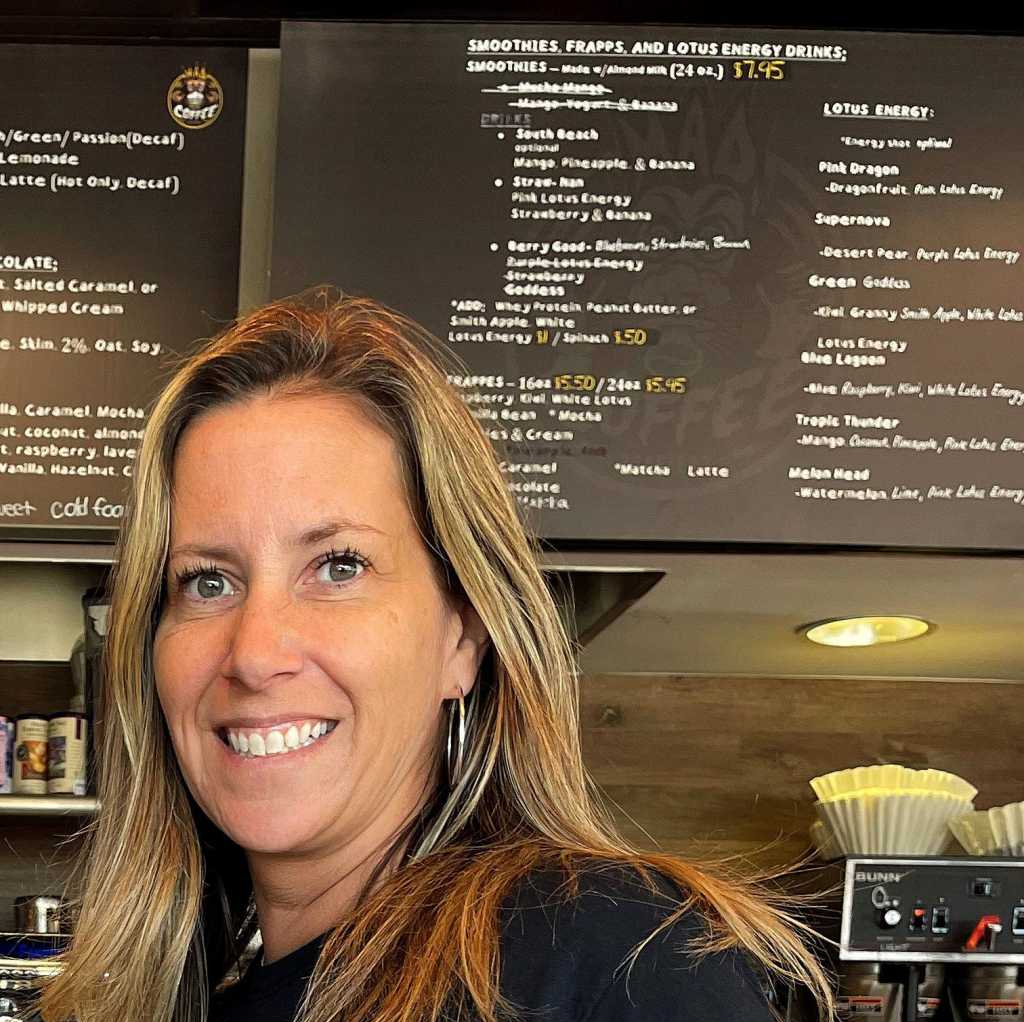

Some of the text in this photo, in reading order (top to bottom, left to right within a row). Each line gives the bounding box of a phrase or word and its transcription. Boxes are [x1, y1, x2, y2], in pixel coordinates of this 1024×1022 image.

[632, 40, 847, 61] AND LOTUS ENERGY DRINKS:
[466, 60, 547, 72] SMOOTHIES
[670, 63, 694, 77] (24
[734, 59, 785, 79] $7.95
[824, 102, 934, 118] LOTUS ENERGY:
[516, 128, 598, 140] South Beach
[649, 158, 695, 170] Banana
[819, 161, 899, 177] Pink Dragon
[0, 174, 46, 186] Latte
[51, 173, 82, 192] (Hot
[127, 175, 179, 194] Decaf)
[512, 192, 631, 207] Pink Lotus Energy
[511, 208, 589, 222] Strawberry
[606, 209, 651, 220] Banana
[815, 212, 890, 226] Supernova
[508, 240, 549, 254] Berry
[14, 278, 157, 293] Salted or
[809, 274, 856, 287] Green
[2, 300, 67, 314] Whipped
[71, 301, 123, 314] Cream
[495, 301, 531, 313] Whey
[533, 301, 581, 312] Protein
[587, 302, 630, 313] Peanut
[450, 315, 575, 328] Smith White
[449, 331, 609, 344] Lotus Energy Spinach
[818, 337, 907, 352] Lotus Energy
[801, 351, 885, 367] Blue Lagoon
[796, 413, 899, 429] Tropic Thunder
[526, 428, 573, 440] Cream
[688, 465, 728, 477] Latte
[789, 467, 869, 480] Melon Head
[92, 497, 123, 517] foa
[855, 872, 900, 882] BUNN
